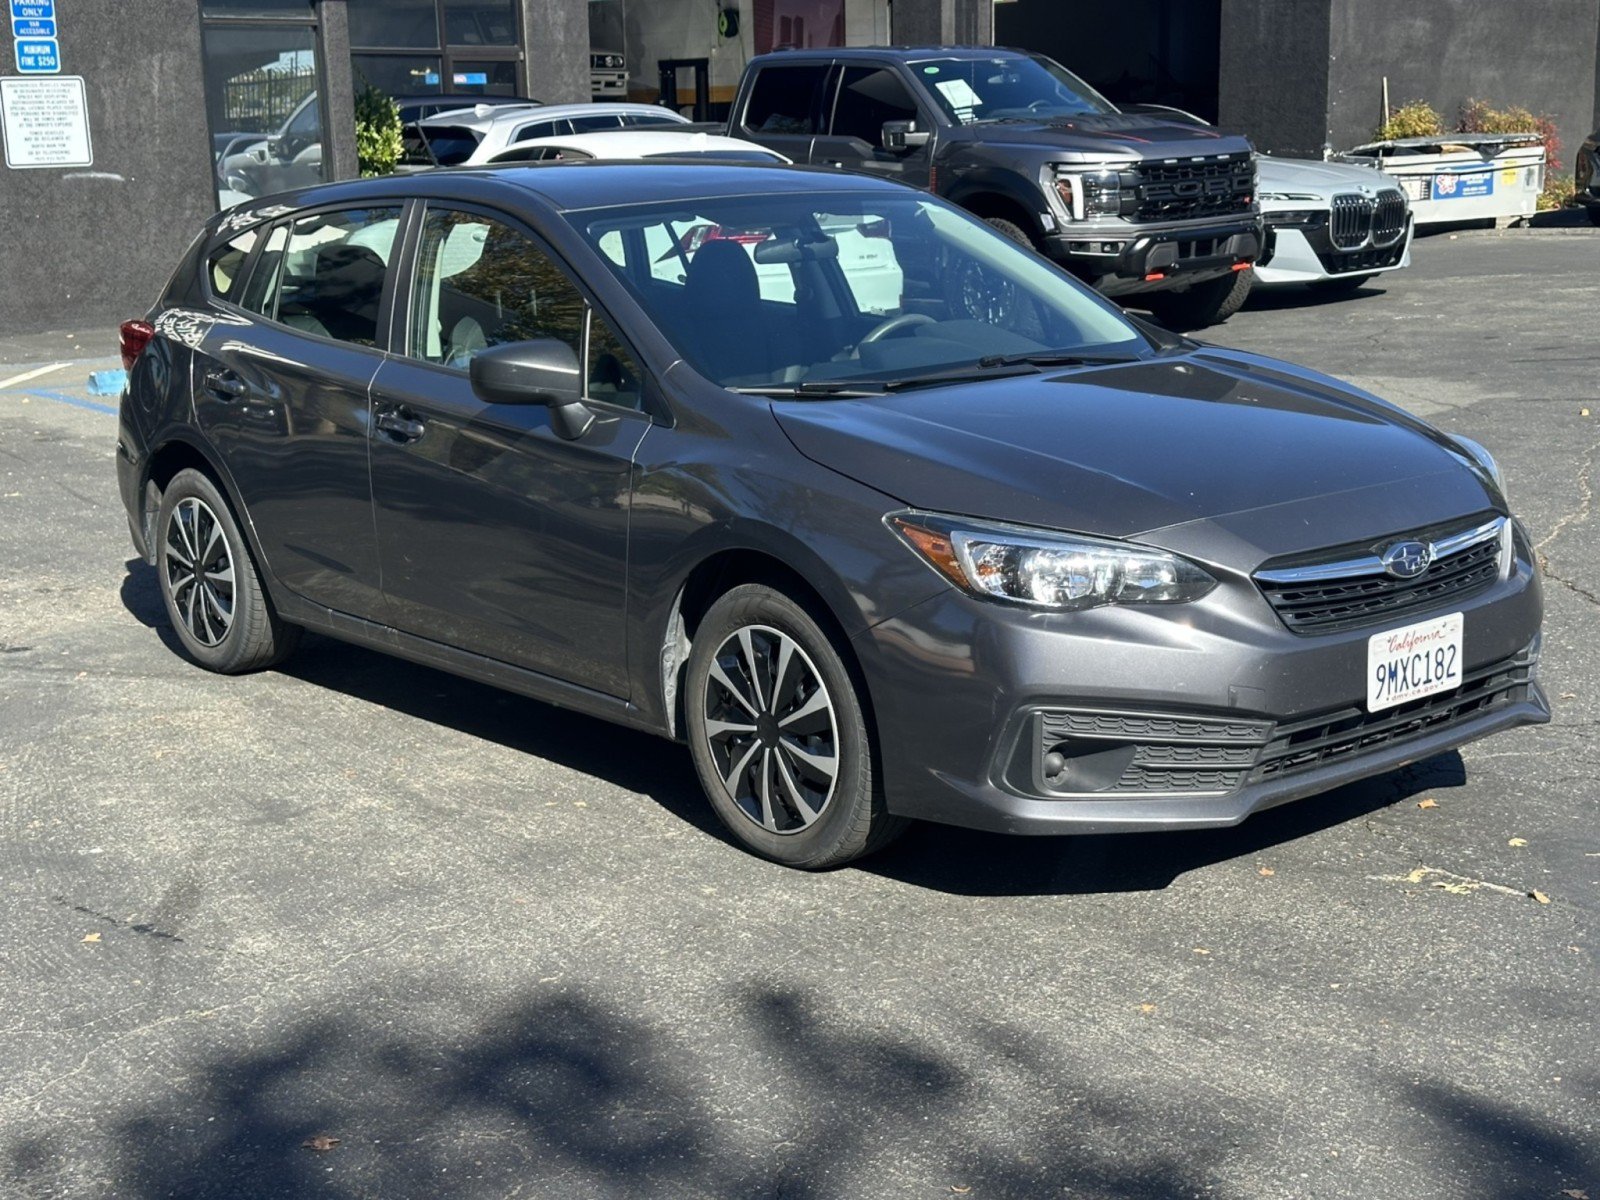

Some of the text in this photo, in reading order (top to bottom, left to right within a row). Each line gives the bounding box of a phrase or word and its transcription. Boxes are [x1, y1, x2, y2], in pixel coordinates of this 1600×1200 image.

[22, 7, 43, 16] ONLY
[21, 55, 55, 66] FINE $250
[1141, 175, 1252, 200] FORD
[1389, 630, 1446, 653] California
[1375, 643, 1456, 700] 9MXC182
[1391, 684, 1439, 701] dmv.ca.gov
